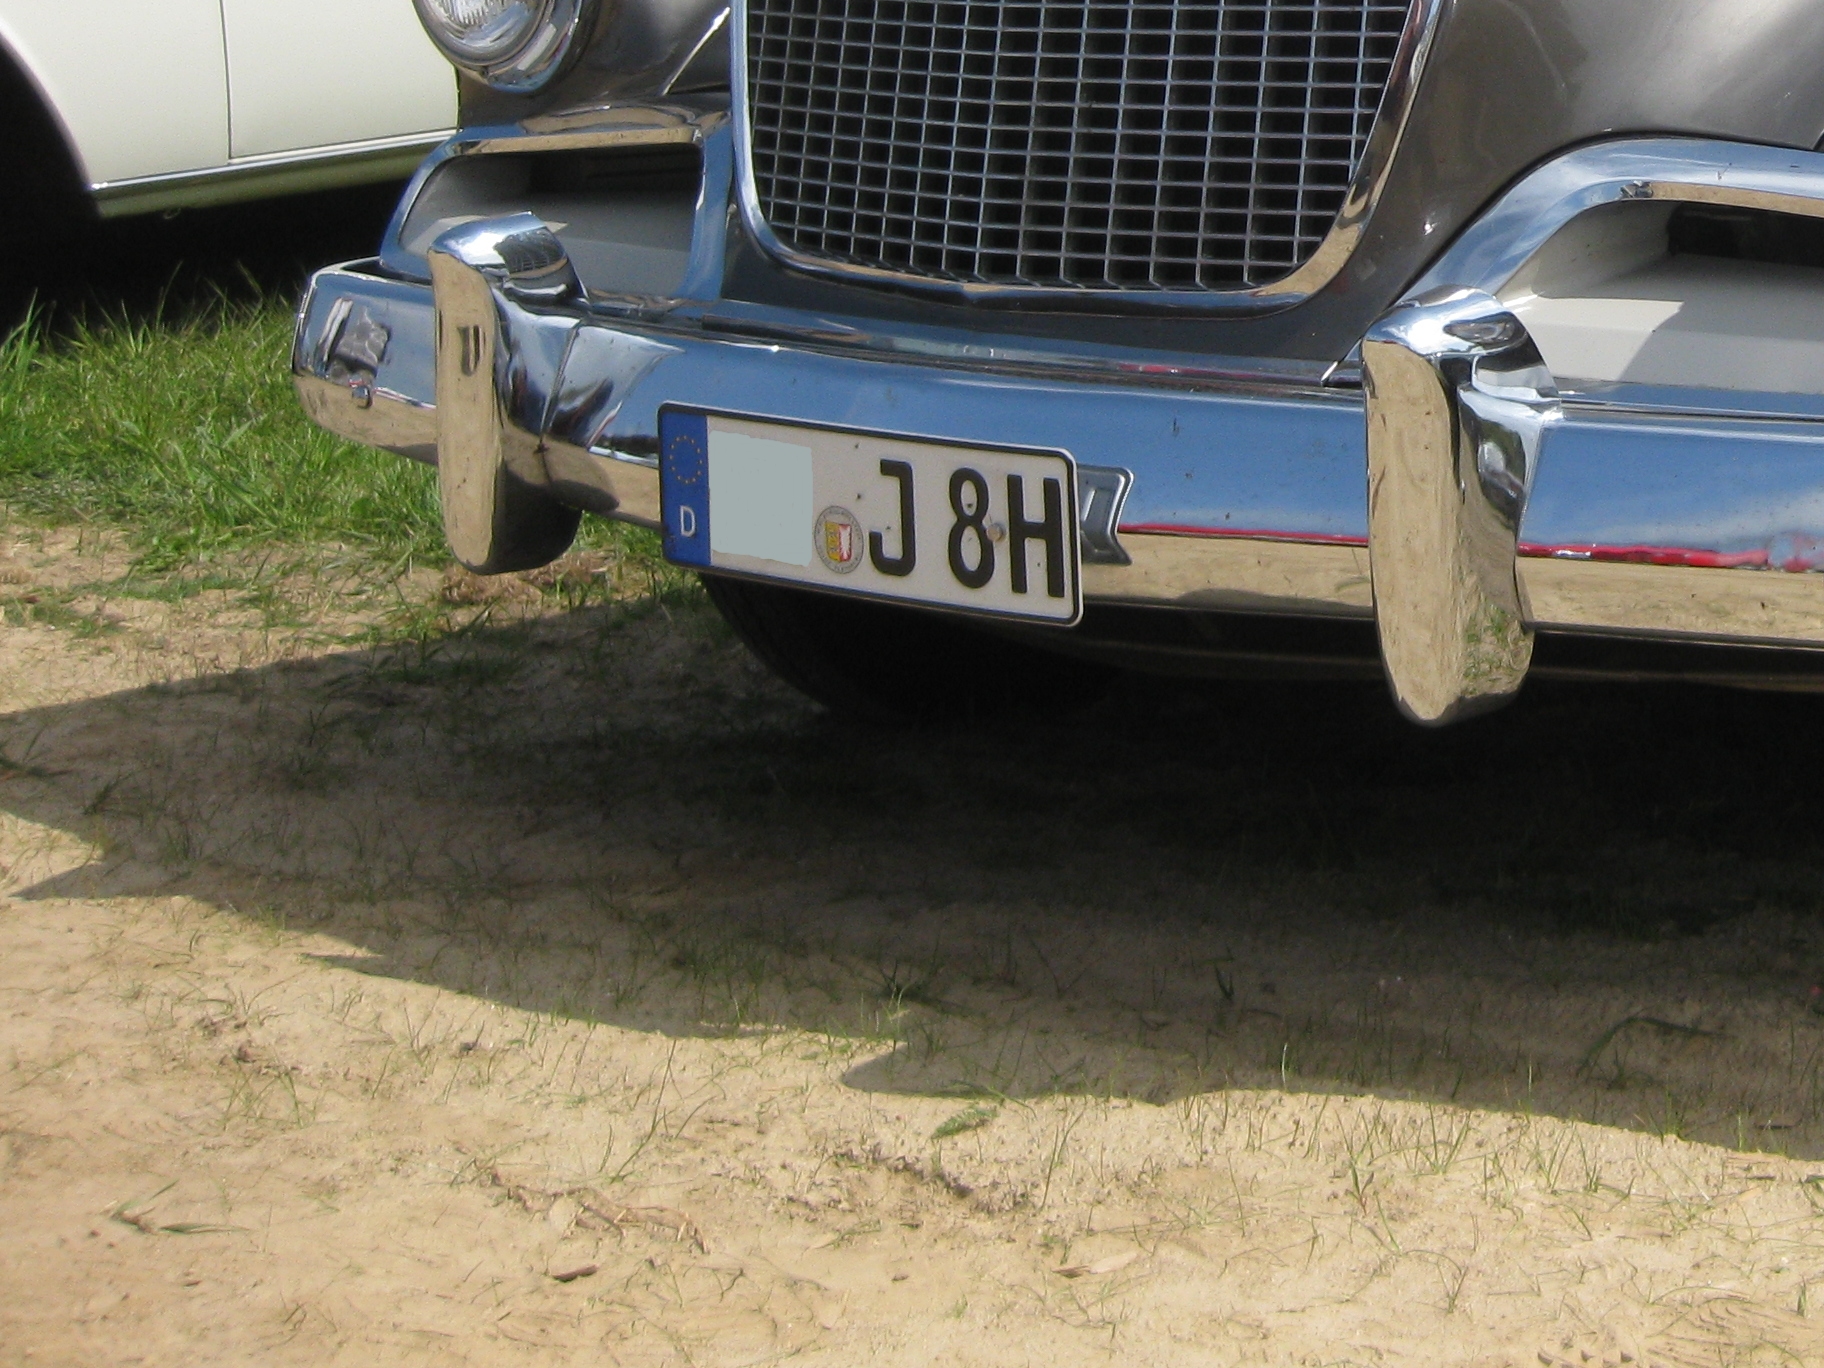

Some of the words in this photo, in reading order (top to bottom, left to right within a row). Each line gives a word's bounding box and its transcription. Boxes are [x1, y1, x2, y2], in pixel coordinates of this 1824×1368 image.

[679, 505, 696, 538] D
[868, 458, 917, 577] J
[947, 467, 1066, 598] 8H
